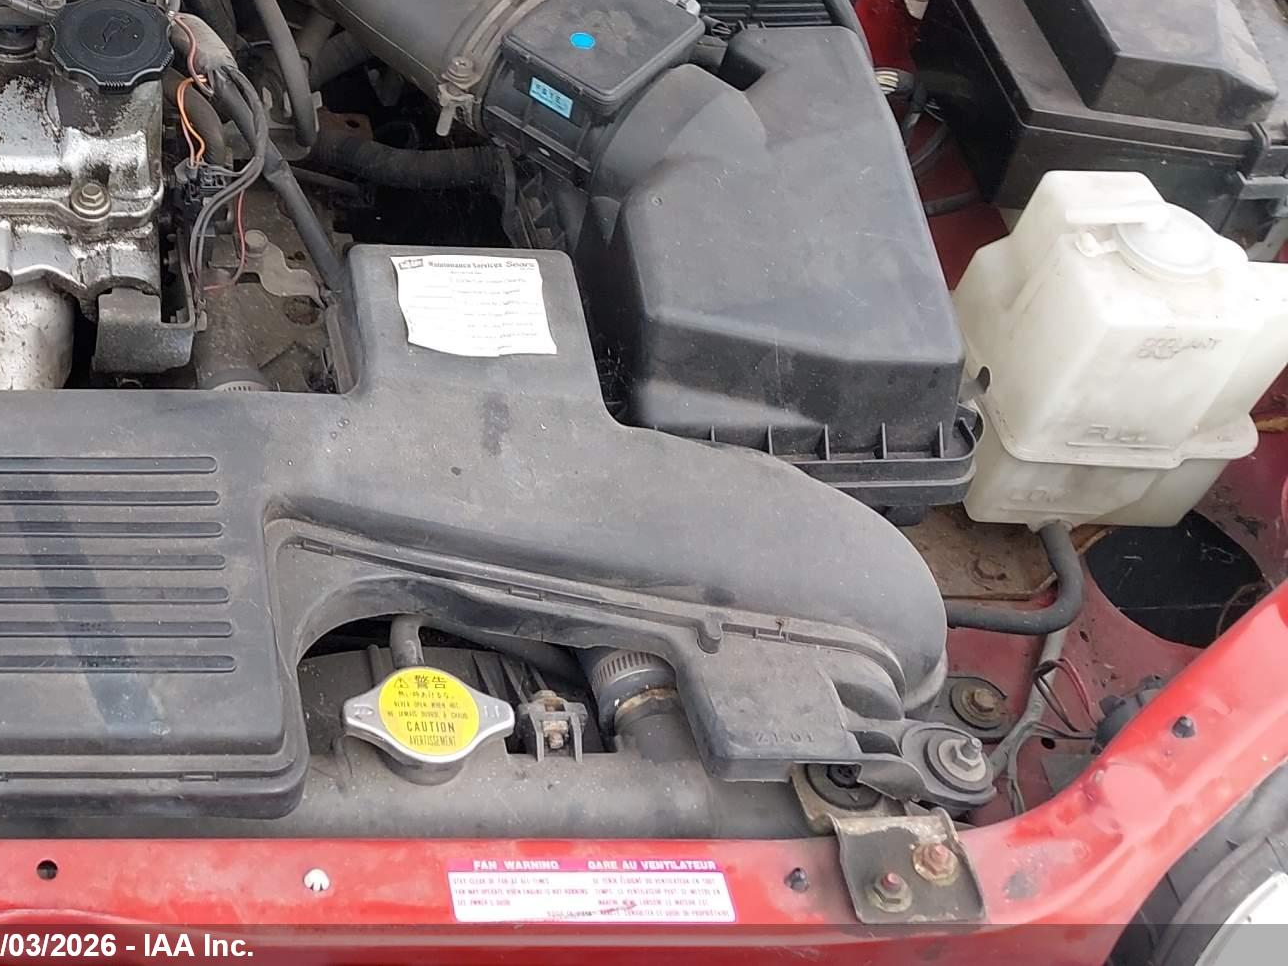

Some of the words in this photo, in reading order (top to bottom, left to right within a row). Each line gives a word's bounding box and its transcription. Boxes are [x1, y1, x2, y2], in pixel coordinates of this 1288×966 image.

[406, 721, 456, 732] CAUTION
[473, 860, 497, 870] FAN
[504, 860, 560, 870] WARNING
[622, 861, 638, 871] AU
[641, 861, 717, 871] VENTILATEUR
